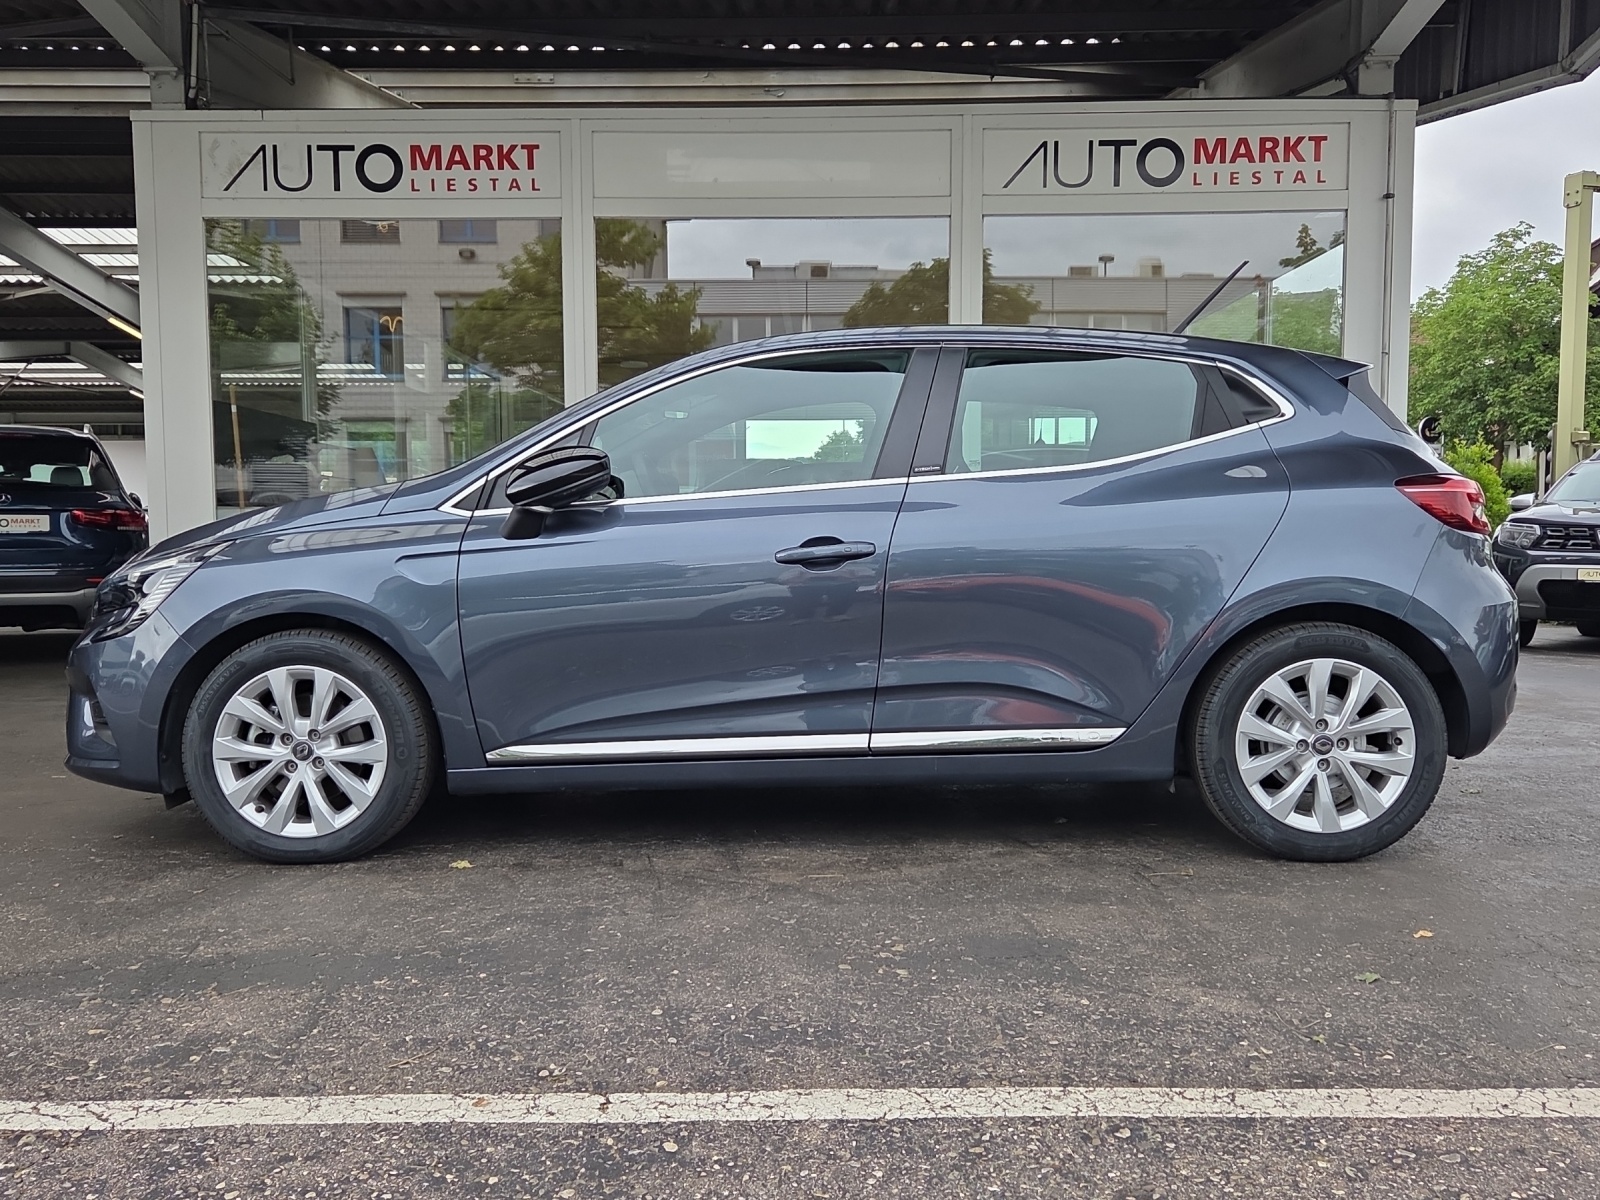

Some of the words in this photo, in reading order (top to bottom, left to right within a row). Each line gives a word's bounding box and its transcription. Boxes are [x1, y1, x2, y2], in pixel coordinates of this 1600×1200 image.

[223, 144, 404, 193] AUTO
[409, 144, 541, 171] MARKT
[1002, 138, 1185, 188] AUTO
[1193, 136, 1328, 164] MARKT
[410, 178, 541, 192] LIESTAL
[1192, 170, 1327, 186] LIESTAL
[1040, 731, 1101, 742] CLIO
